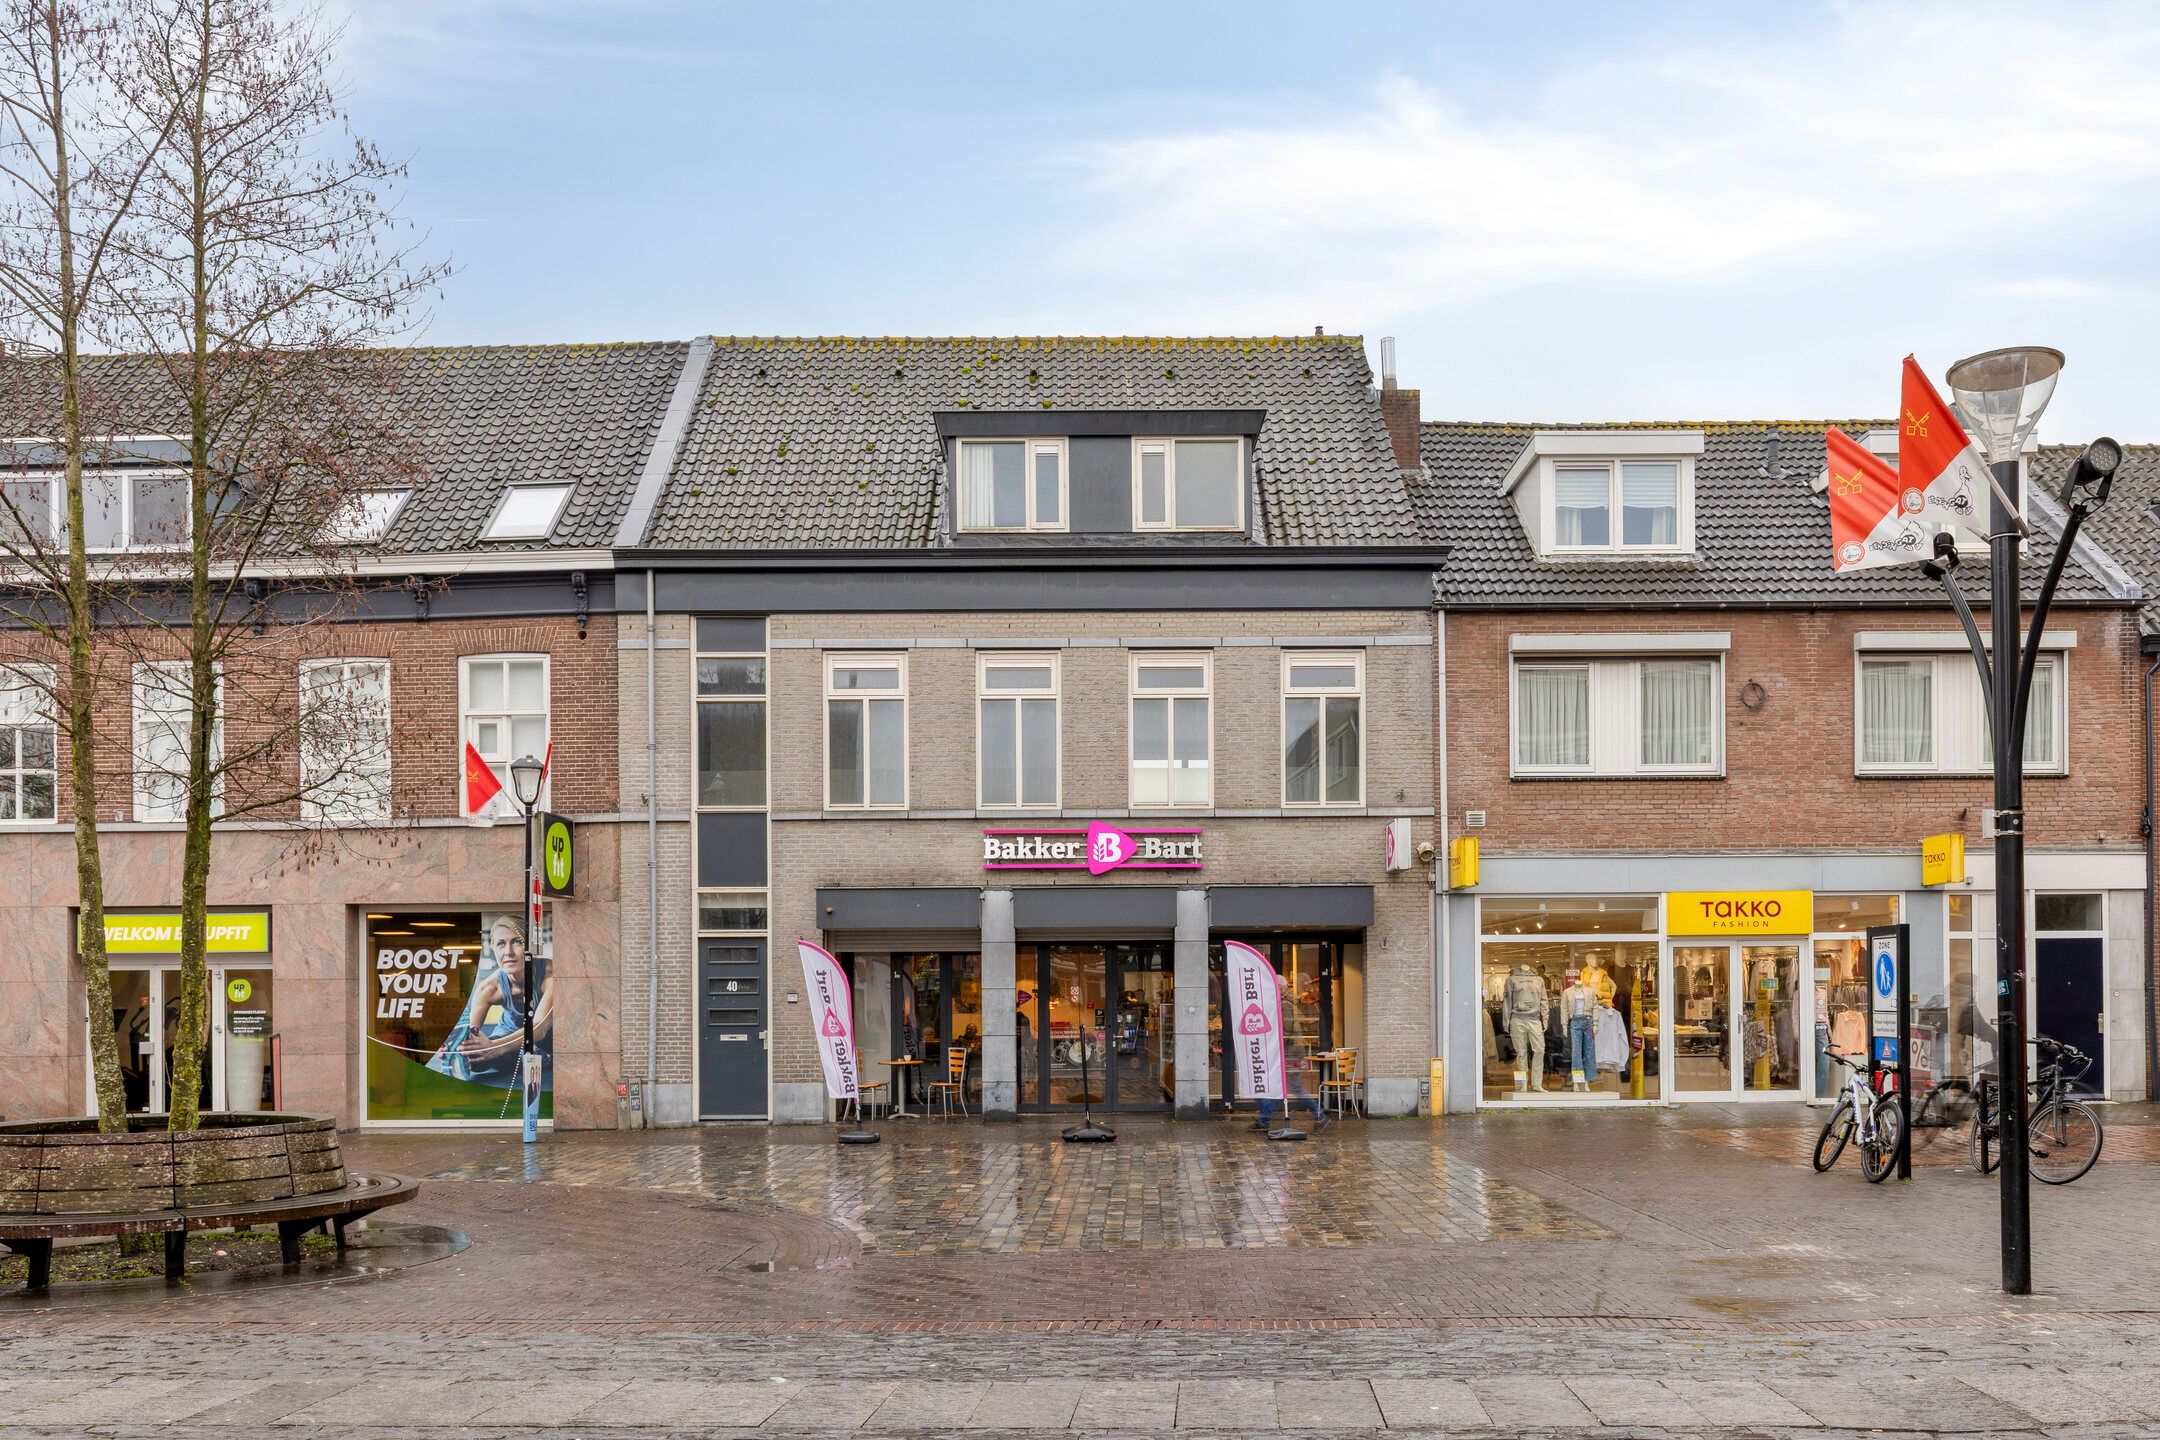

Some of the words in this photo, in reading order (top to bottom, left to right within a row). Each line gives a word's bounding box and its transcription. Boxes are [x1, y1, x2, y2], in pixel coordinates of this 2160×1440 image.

[551, 835, 565, 860] up
[983, 836, 1080, 859] Bakker
[1144, 837, 1203, 859] Bart
[553, 853, 565, 878] fit
[206, 925, 252, 941] UPFIT
[1879, 941, 1890, 949] ZONE
[376, 949, 464, 970] BOOST
[378, 973, 448, 994] YOUR
[727, 981, 738, 992] 40
[376, 998, 425, 1018] LIFE
